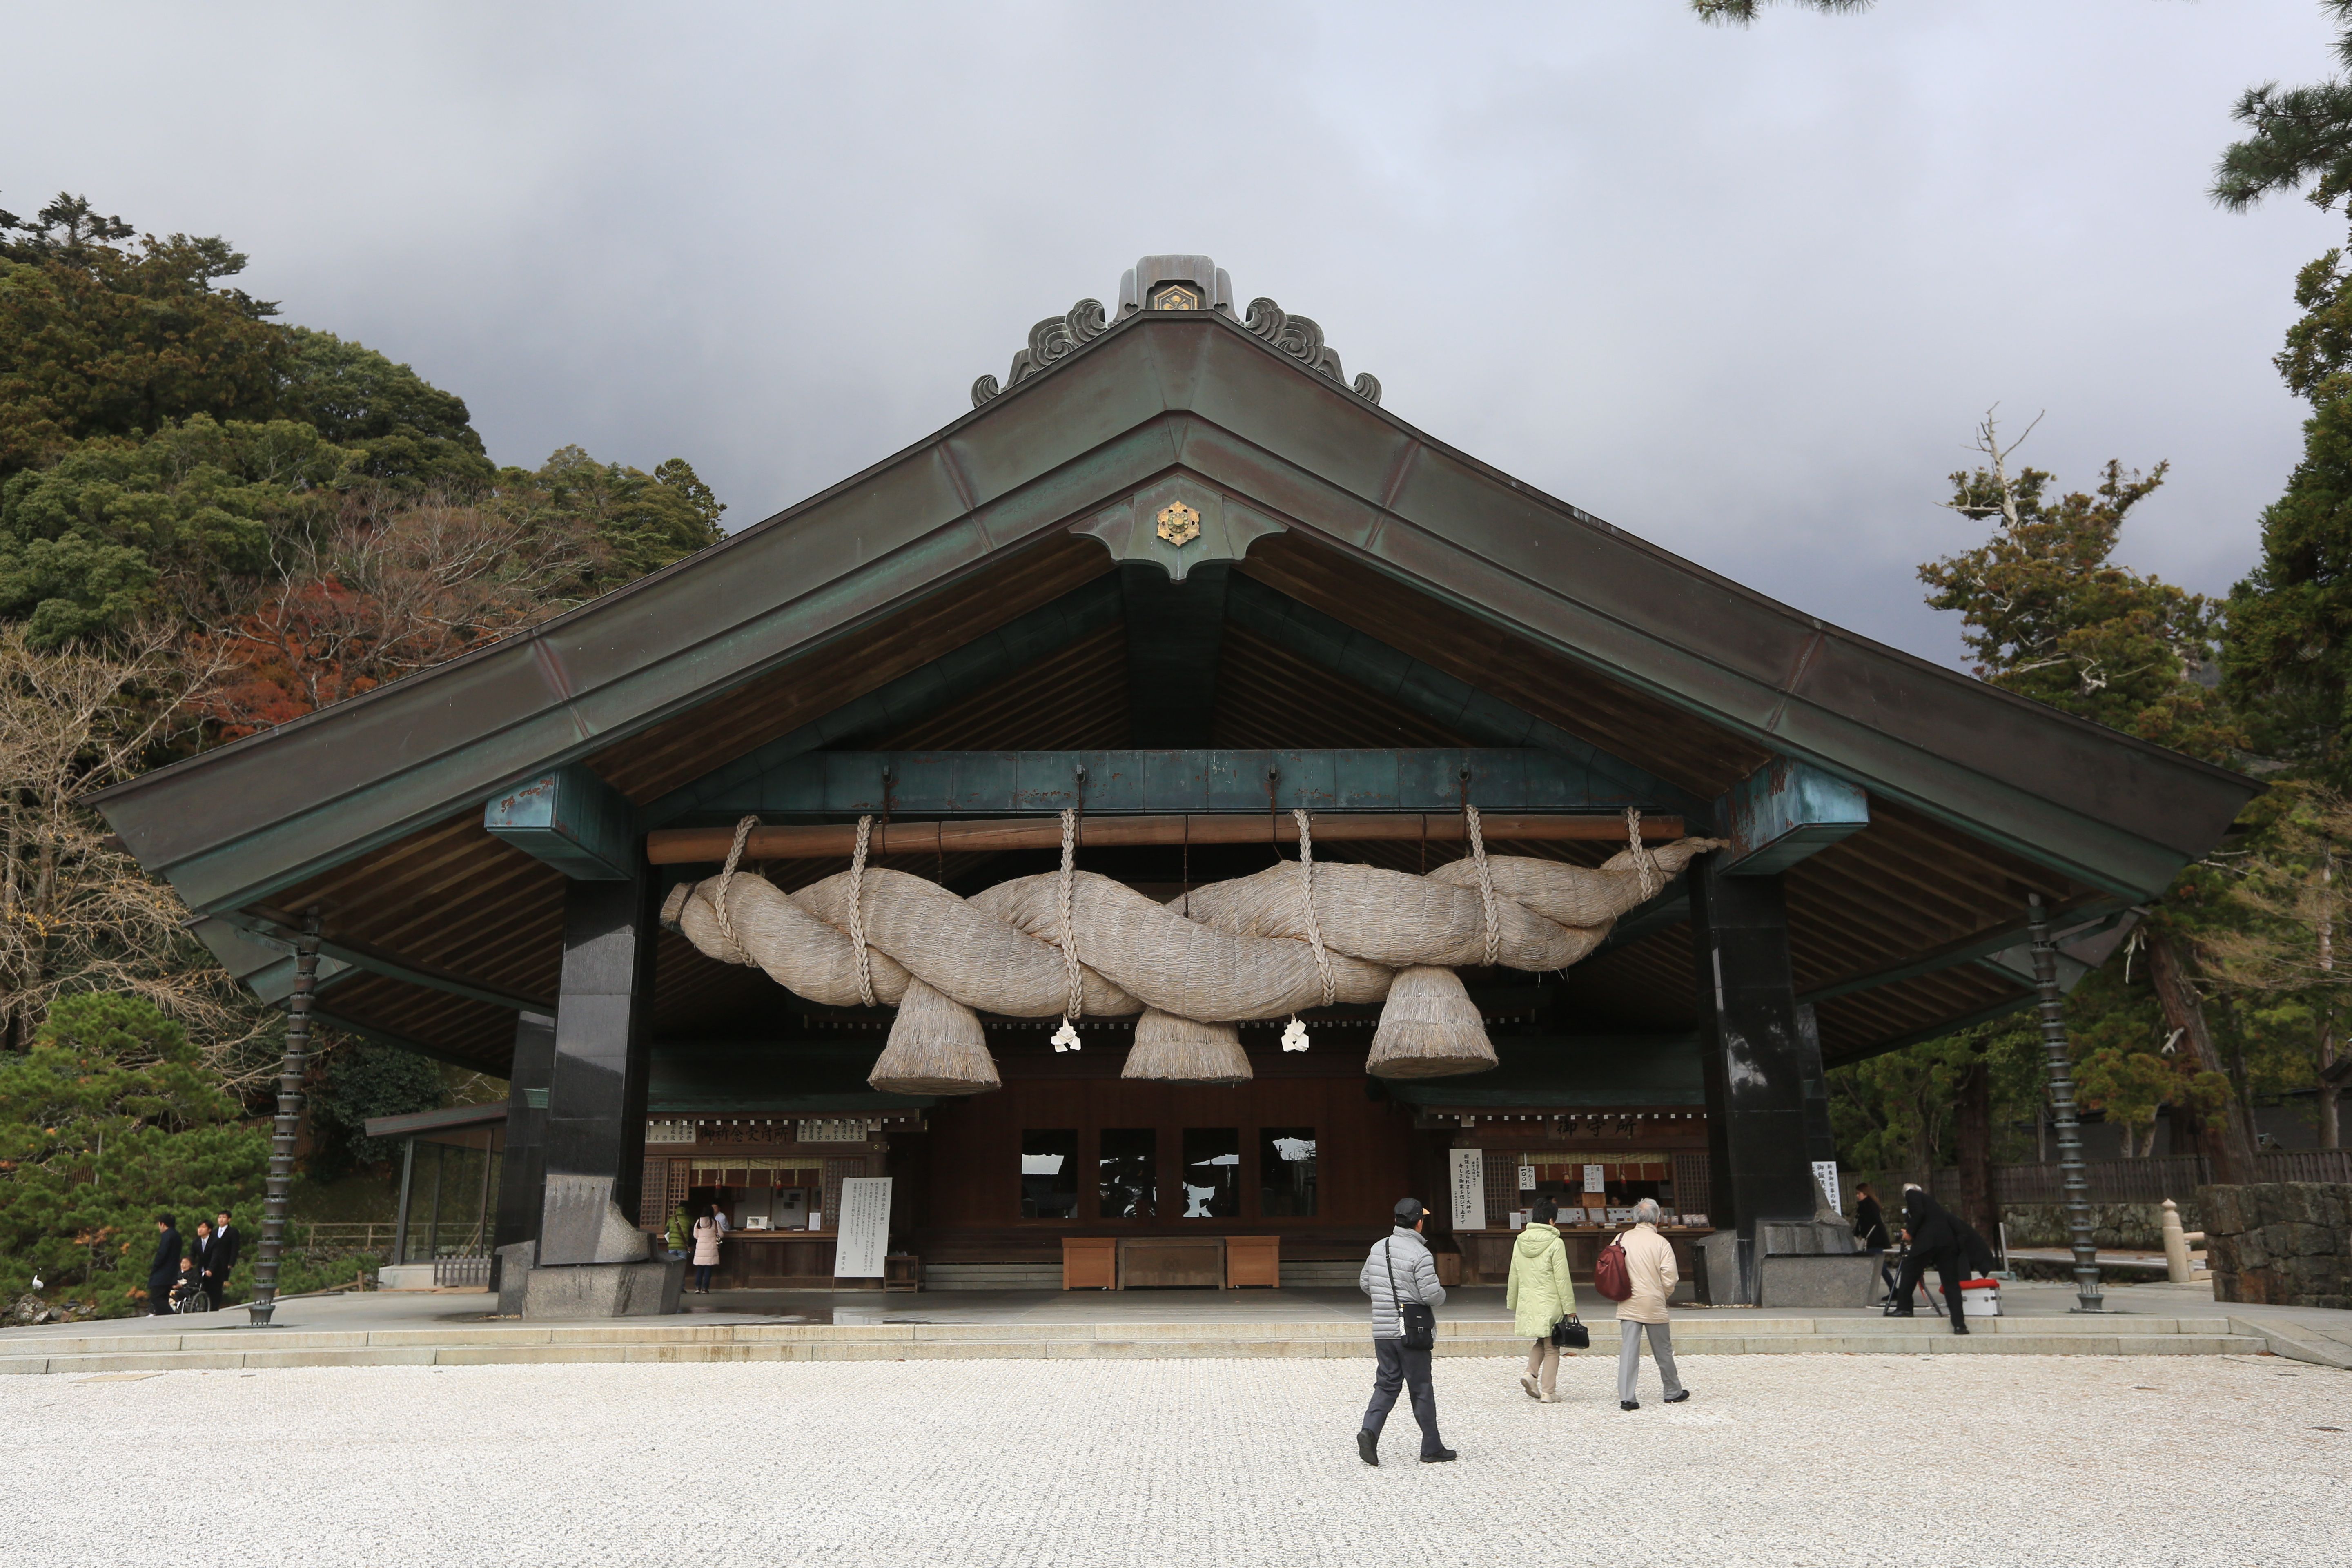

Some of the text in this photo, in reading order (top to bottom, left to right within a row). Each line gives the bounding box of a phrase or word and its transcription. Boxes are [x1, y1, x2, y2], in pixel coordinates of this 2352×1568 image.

[700, 1126, 788, 1143] 御祈念受付所
[1556, 1118, 1637, 1137] 御守所
